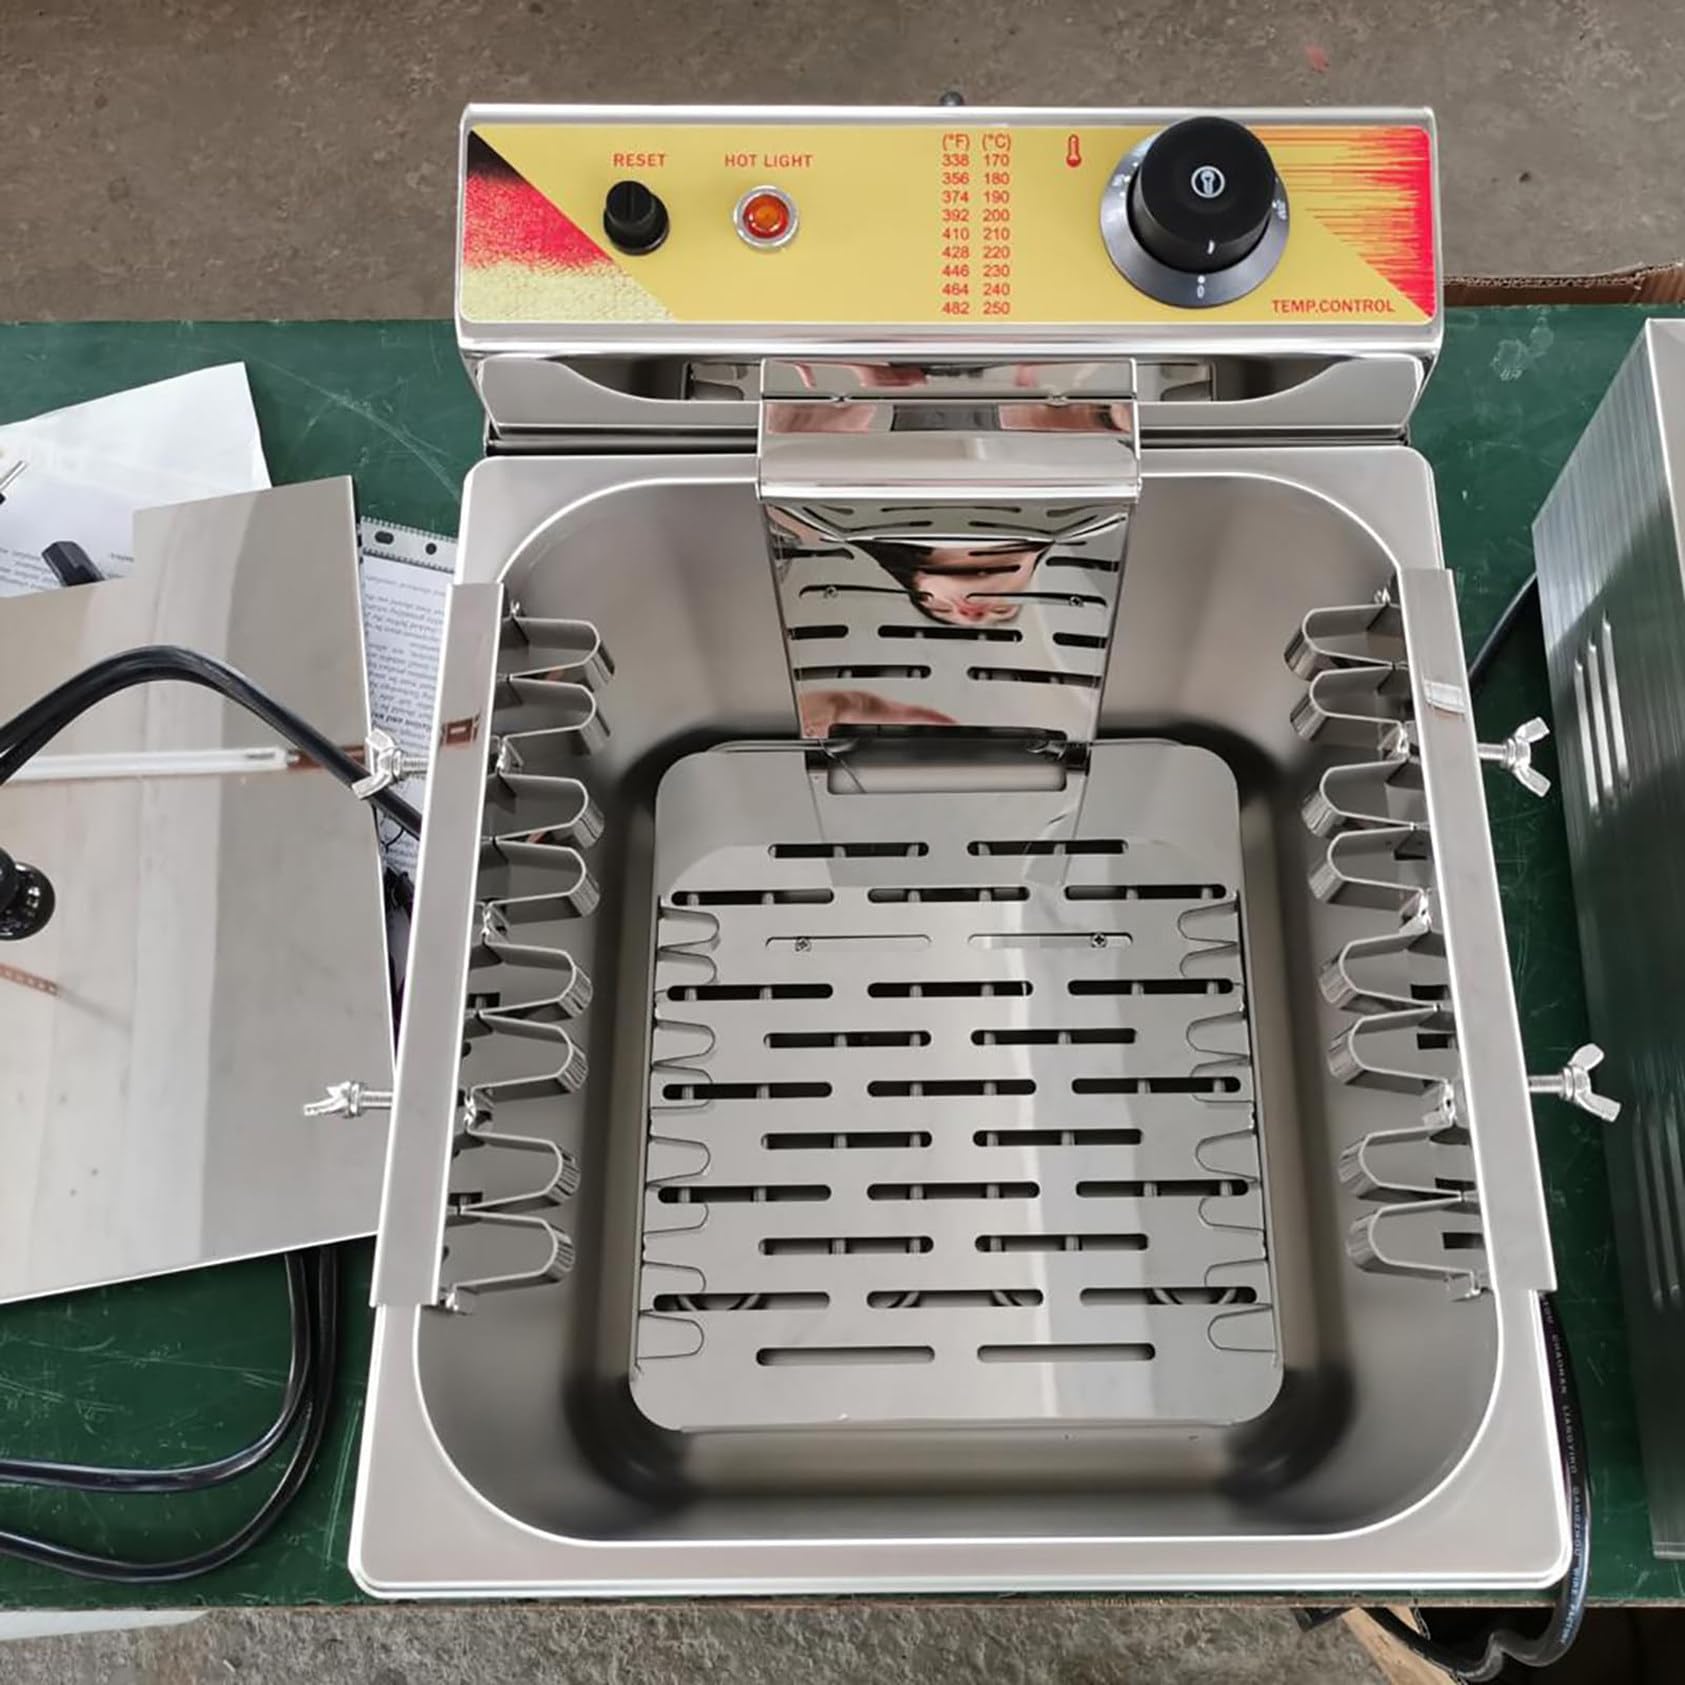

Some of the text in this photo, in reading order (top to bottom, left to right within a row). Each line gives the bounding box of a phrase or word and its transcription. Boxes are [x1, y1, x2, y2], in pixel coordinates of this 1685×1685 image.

[613, 153, 666, 167] RESET
[724, 153, 813, 168] HOT LIGHT
[942, 154, 1011, 167] 338 170
[942, 172, 1011, 185] 356 180
[942, 190, 1011, 203] 374 190
[942, 209, 1011, 222] 392 200
[942, 227, 1011, 240] 410 210
[942, 246, 1011, 259] 428 220
[942, 264, 1011, 277] 446 230
[942, 283, 1011, 296] 464 240
[942, 301, 1011, 314] 482 250
[1272, 299, 1394, 314] TEMP.CONTROL
